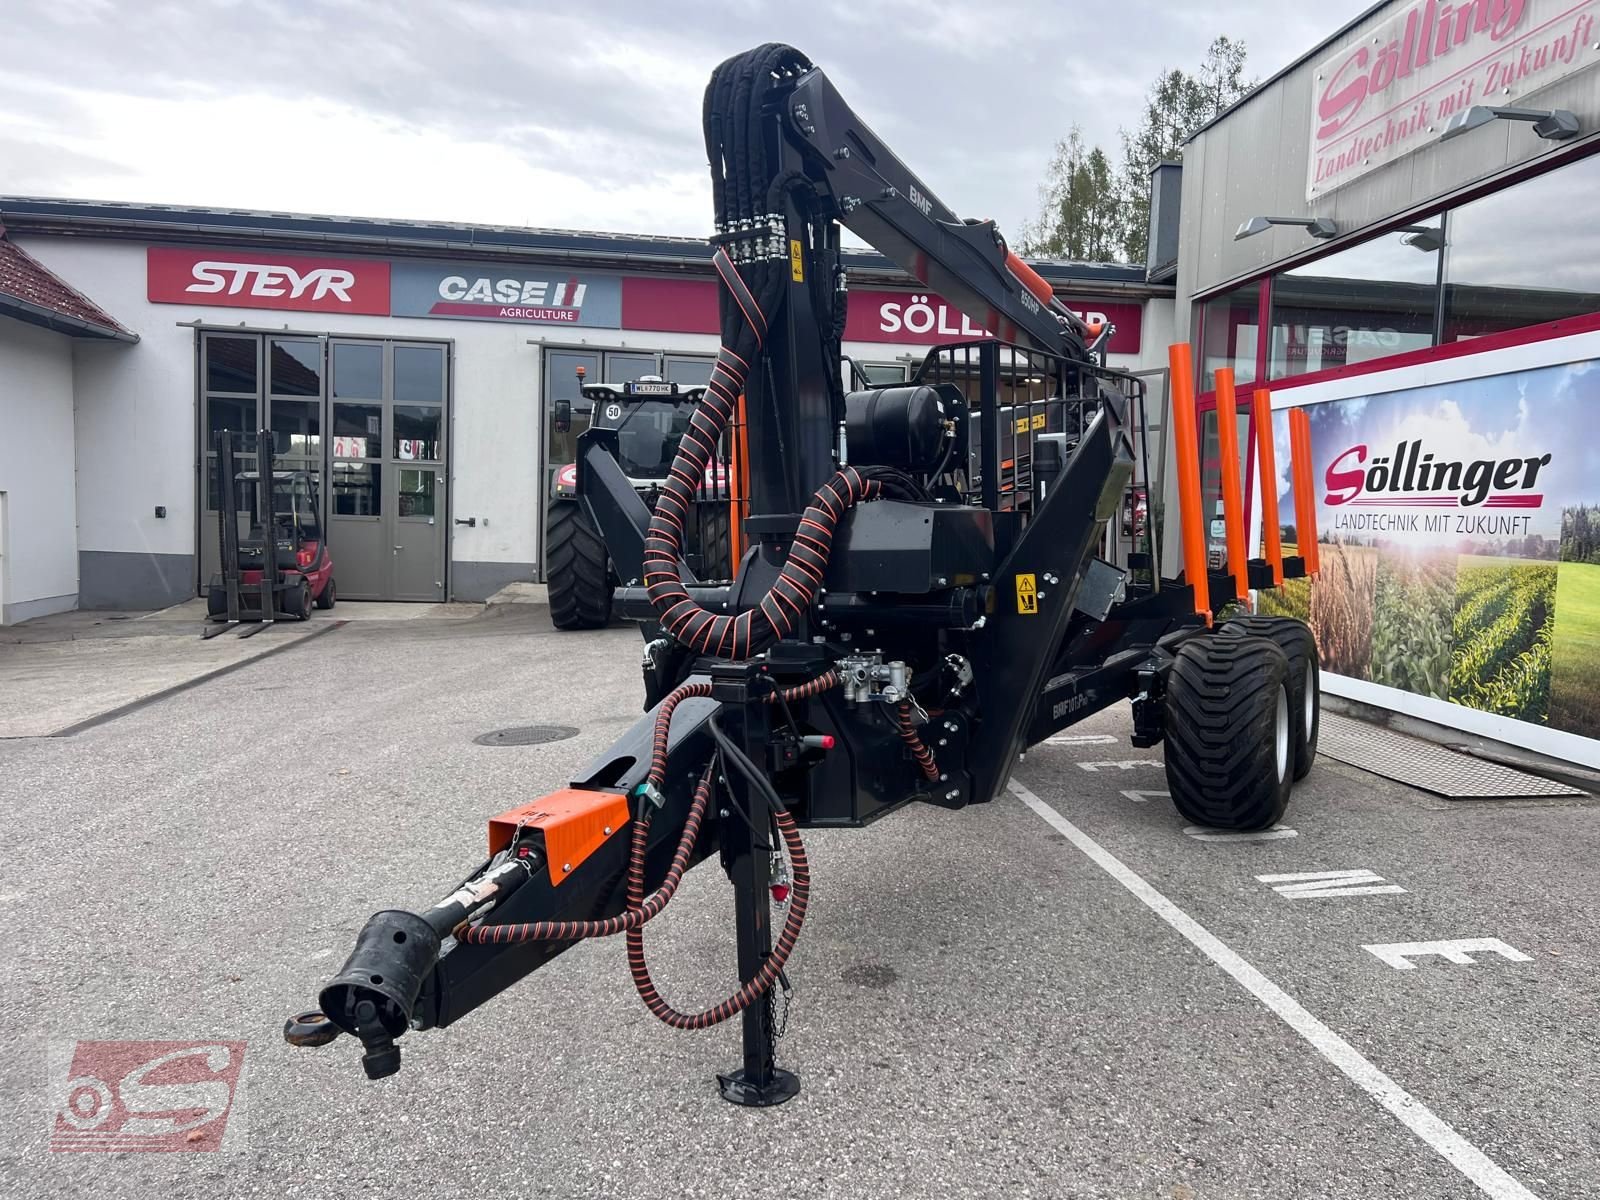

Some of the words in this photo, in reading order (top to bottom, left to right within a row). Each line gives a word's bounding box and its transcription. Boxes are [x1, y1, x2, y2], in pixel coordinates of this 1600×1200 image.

[1315, 101, 1430, 183] Landtechnik
[1437, 79, 1475, 121] mit
[1482, 13, 1594, 97] Zukunft
[910, 184, 933, 216] BMF
[184, 260, 355, 302] STEYR
[438, 275, 549, 305] CASE
[499, 307, 574, 321] AGRICULTURE
[608, 407, 619, 419] 50
[1324, 439, 1552, 507] Söllinger
[1335, 513, 1418, 532] LANDTECHNIK
[1424, 515, 1451, 533] MIT
[1456, 515, 1531, 536] ZUKUNFT
